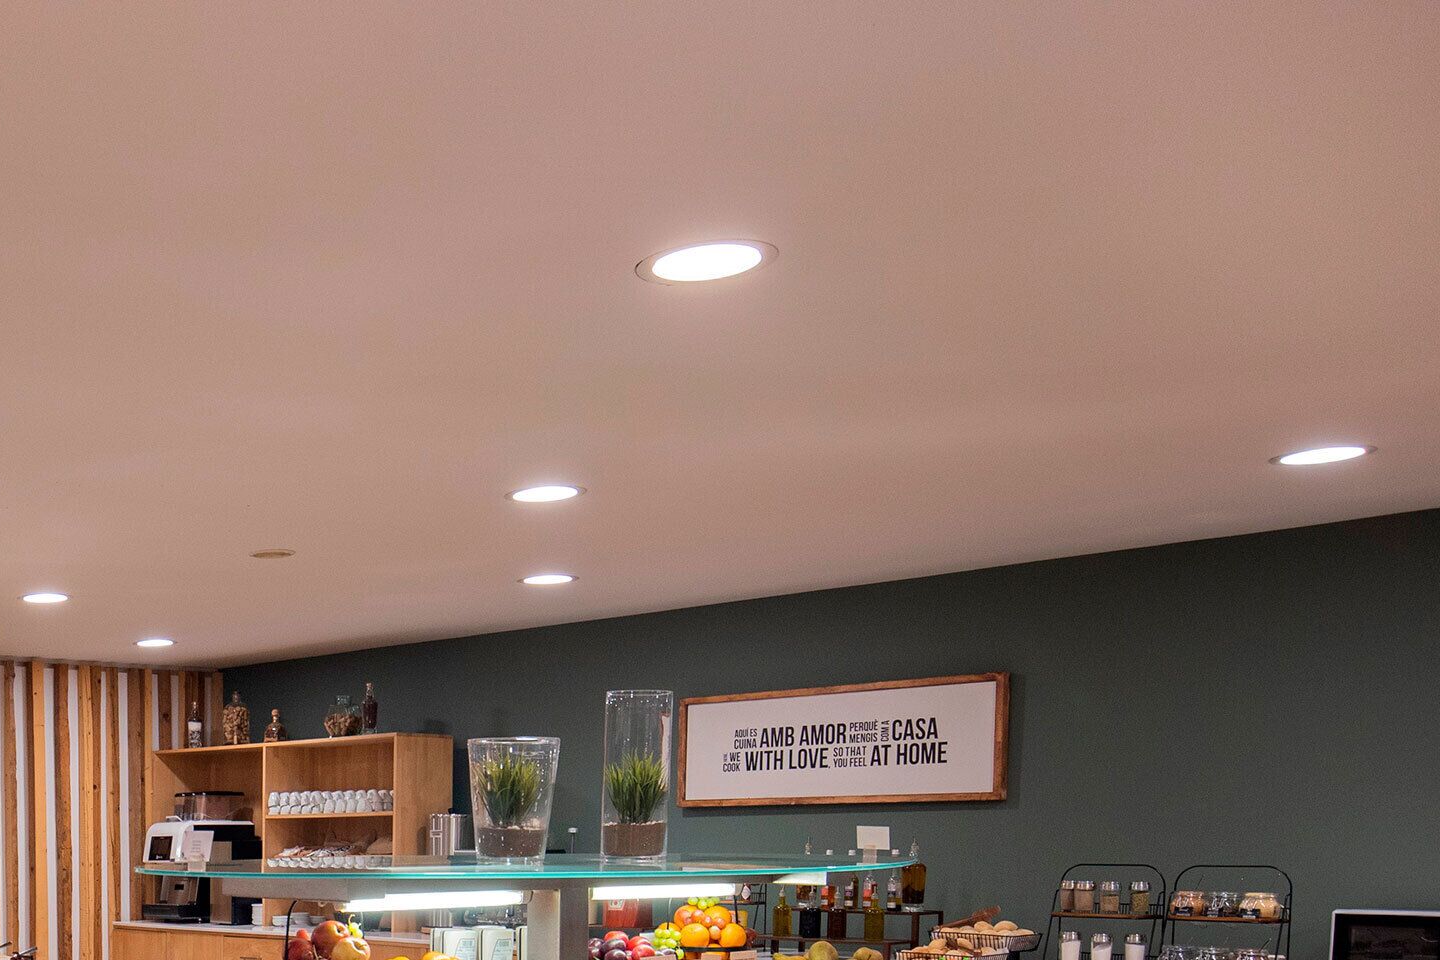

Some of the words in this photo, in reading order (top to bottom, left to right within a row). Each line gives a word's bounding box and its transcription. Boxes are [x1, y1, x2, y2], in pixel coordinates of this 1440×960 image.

[849, 719, 878, 732] PERQUÈ
[892, 717, 938, 741] CASA
[750, 728, 758, 738] ES
[760, 726, 795, 748] AMB
[800, 723, 846, 746] AMOR
[848, 732, 878, 744] MENGIS
[880, 727, 890, 742] COM
[734, 738, 757, 750] CUINA
[729, 752, 740, 762] WE
[833, 746, 844, 758] SO
[846, 745, 867, 757] THAT
[870, 744, 892, 766] AT
[896, 742, 948, 766] HOME
[745, 749, 784, 771] WITH
[833, 758, 848, 768] YOU
[849, 757, 867, 768] FEEL
[722, 762, 740, 772] COOK
